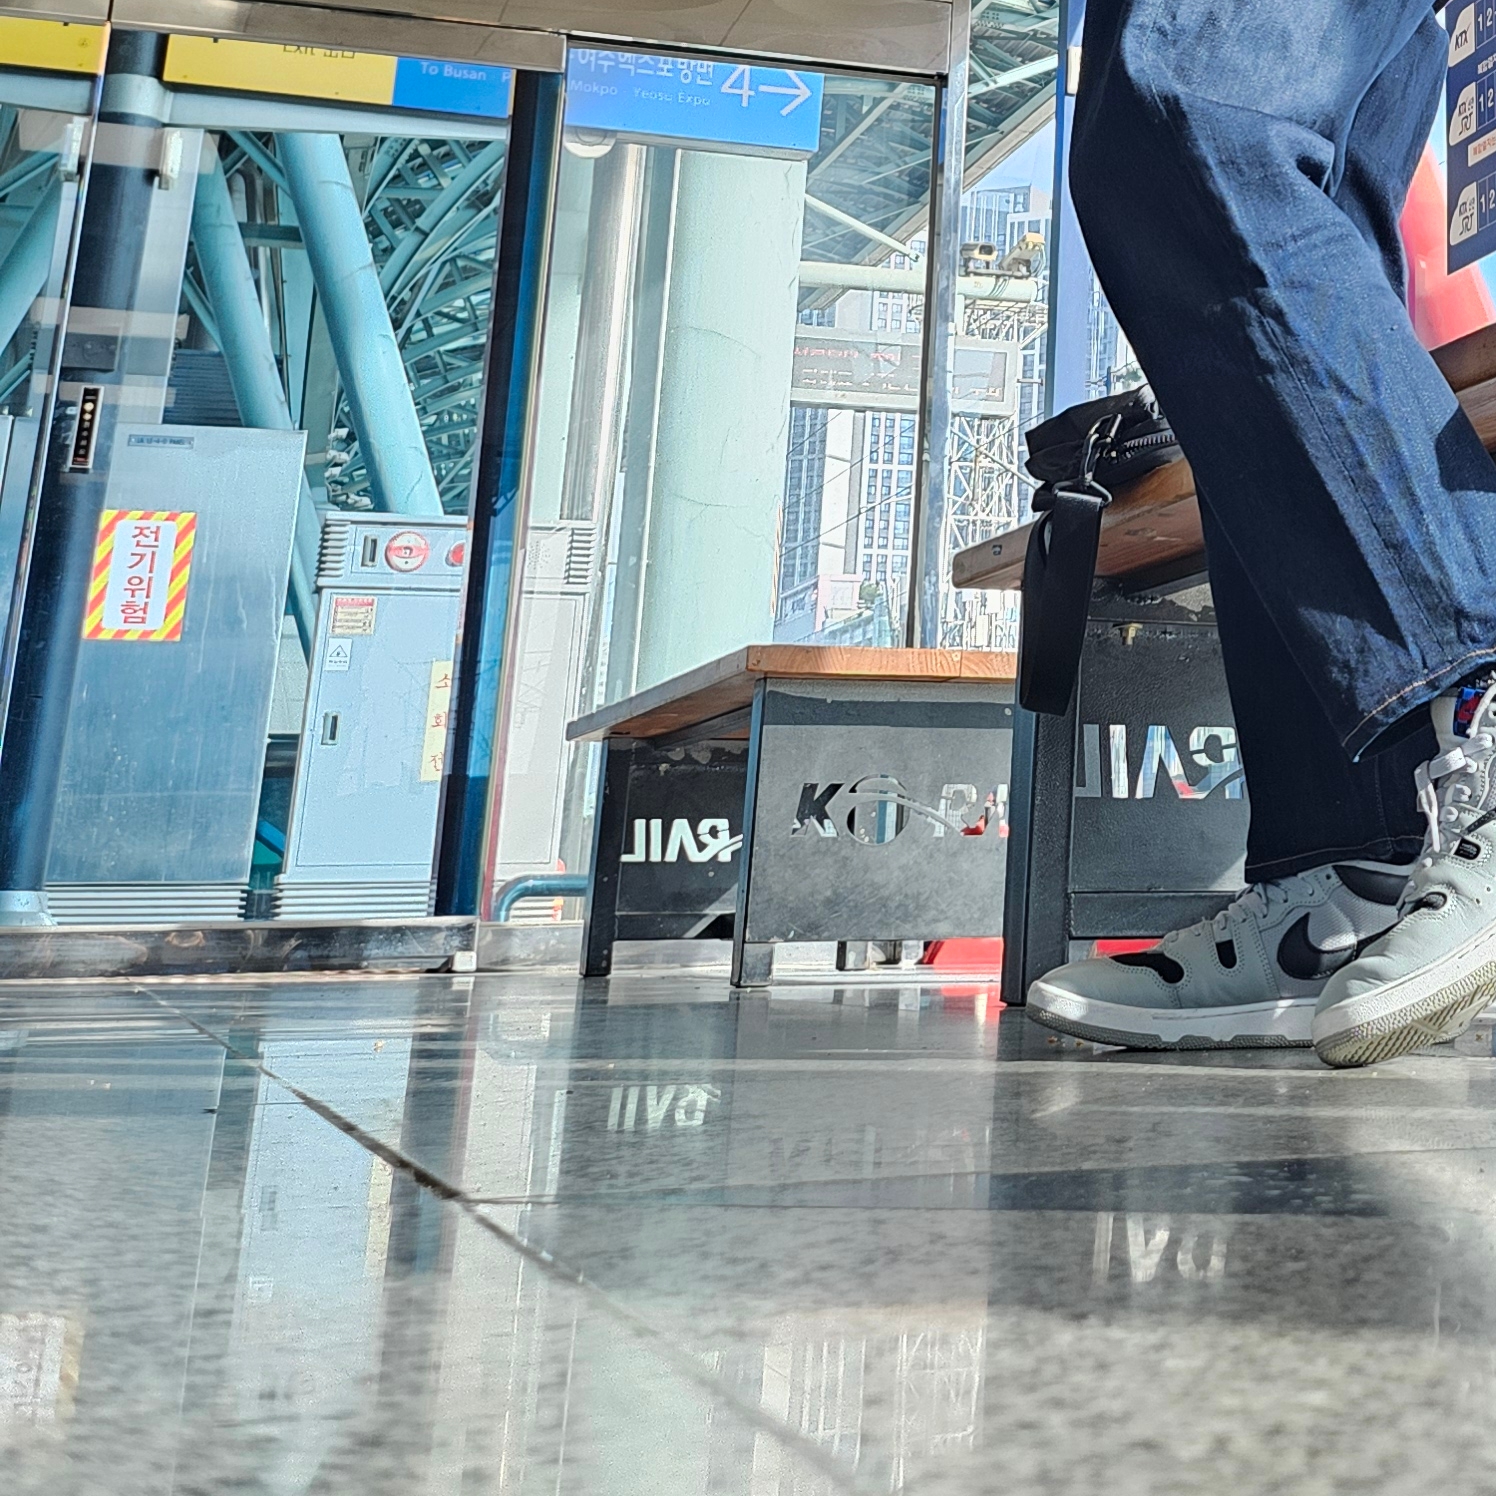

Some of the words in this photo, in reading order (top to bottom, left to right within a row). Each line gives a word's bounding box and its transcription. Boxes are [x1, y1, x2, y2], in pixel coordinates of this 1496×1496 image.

[1478, 13, 1483, 31] 1
[1486, 8, 1493, 27] 2
[420, 61, 438, 75] To
[443, 64, 487, 81] Busan
[570, 80, 618, 96] Mokpo
[720, 65, 756, 107] 4
[1479, 93, 1484, 112] 1
[1487, 88, 1494, 108] 2
[1480, 194, 1485, 213] 1
[1489, 189, 1495, 209] 2
[120, 525, 161, 625] 전기위험
